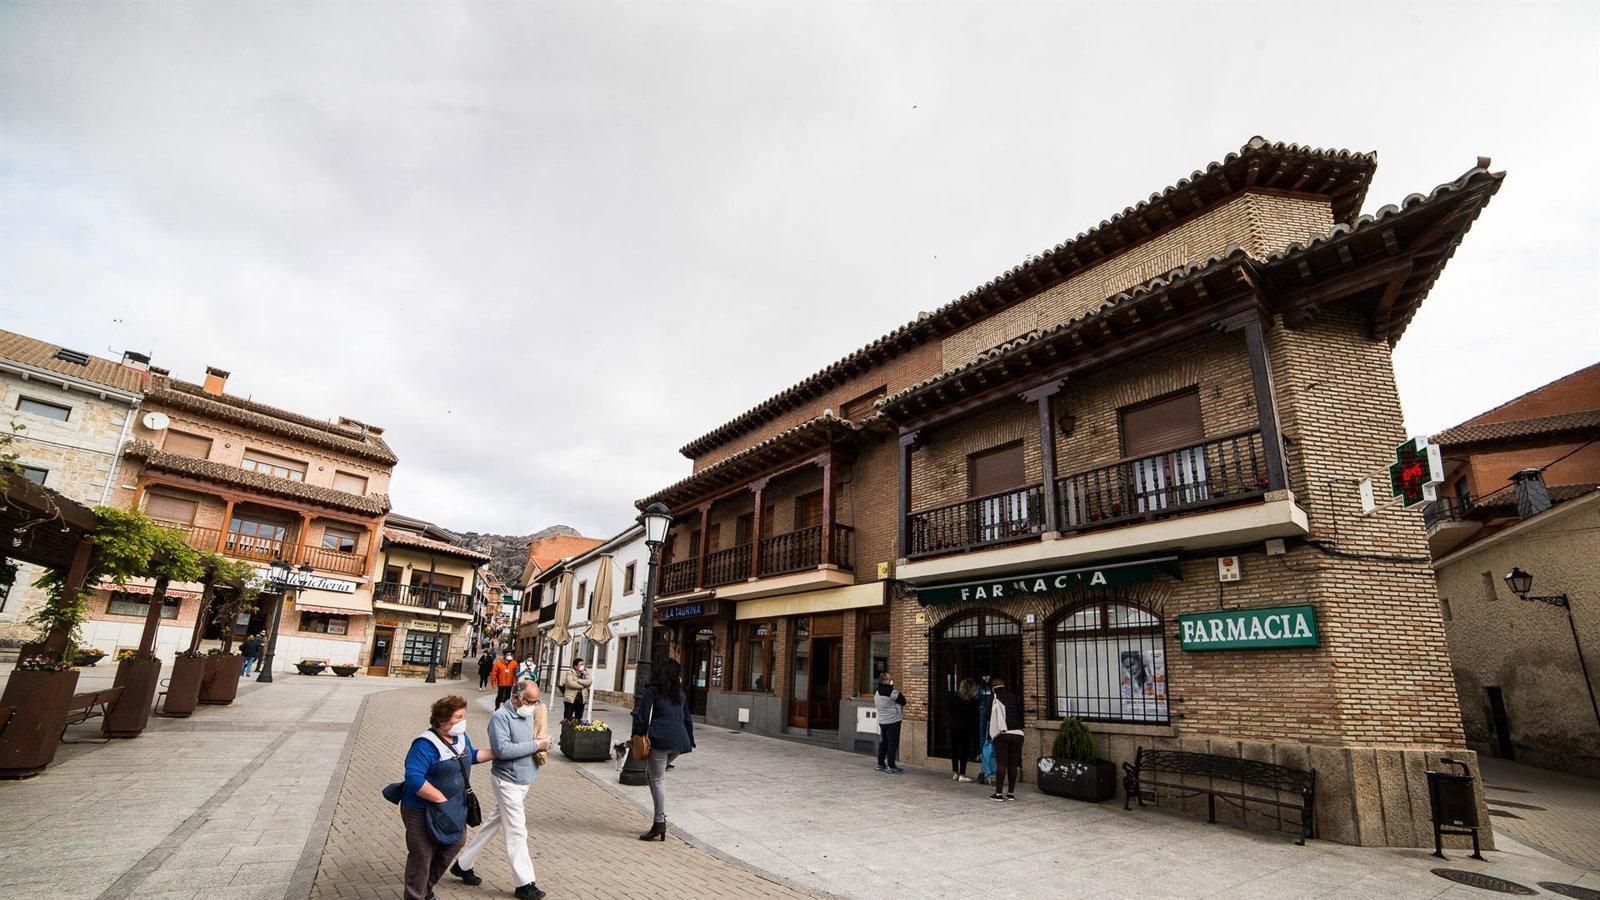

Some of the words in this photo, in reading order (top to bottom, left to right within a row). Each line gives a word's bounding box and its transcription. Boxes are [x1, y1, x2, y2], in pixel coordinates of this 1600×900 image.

[960, 571, 1107, 601] FARMACA
[666, 608, 674, 618] LA
[675, 604, 701, 617] TAURINA
[1182, 613, 1313, 643] FARMACIA
